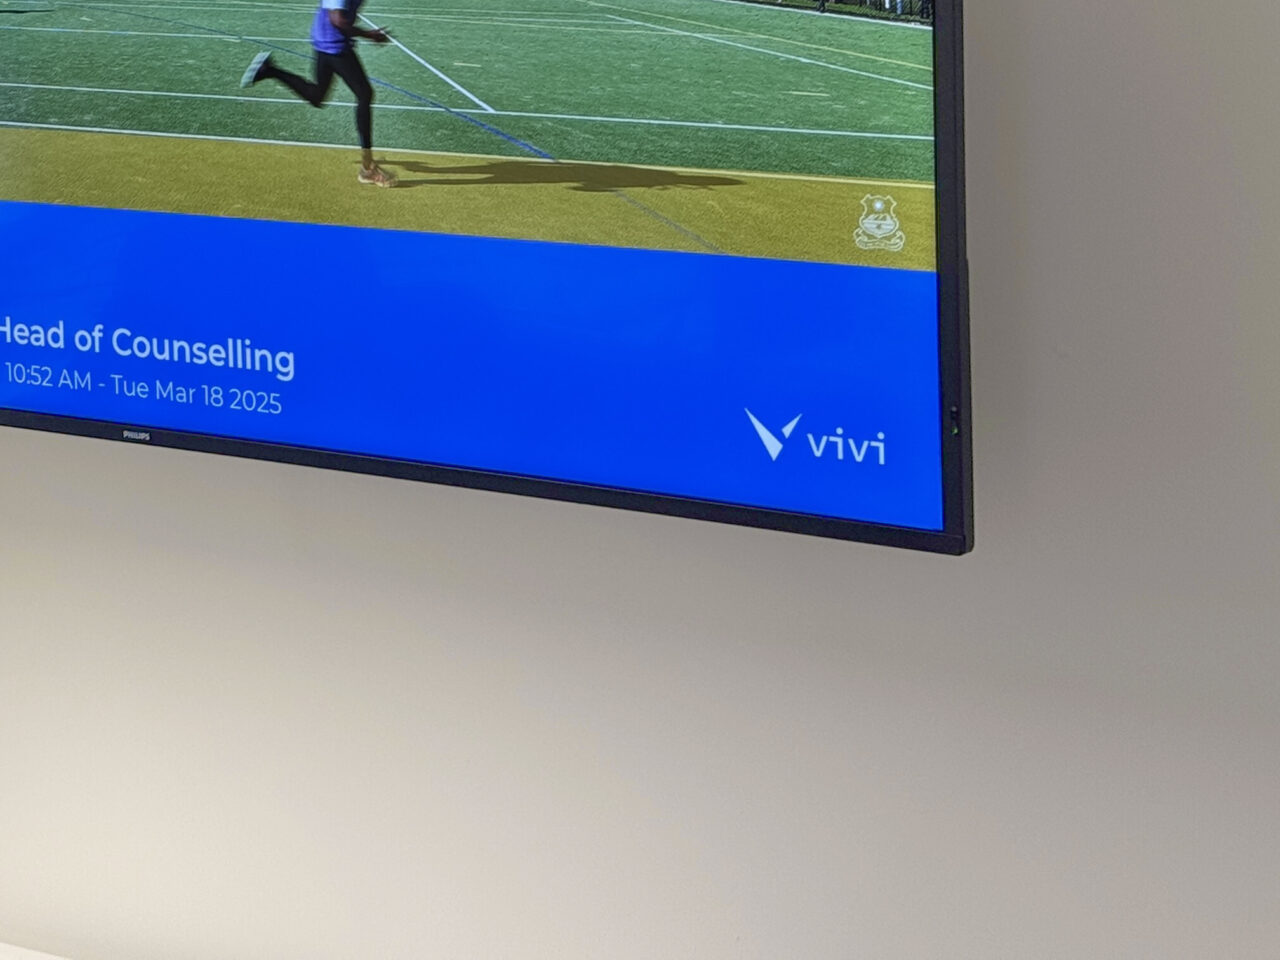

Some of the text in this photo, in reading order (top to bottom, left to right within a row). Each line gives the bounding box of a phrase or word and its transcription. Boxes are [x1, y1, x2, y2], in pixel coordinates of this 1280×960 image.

[74, 323, 104, 353] of
[111, 327, 295, 382] Counselling
[4, 361, 54, 387] 10:52
[57, 368, 91, 392] AM
[110, 374, 149, 399] Tue
[155, 379, 196, 404] Mar
[201, 384, 224, 407] 18
[228, 388, 282, 415] 2025
[807, 427, 885, 465] vivi
